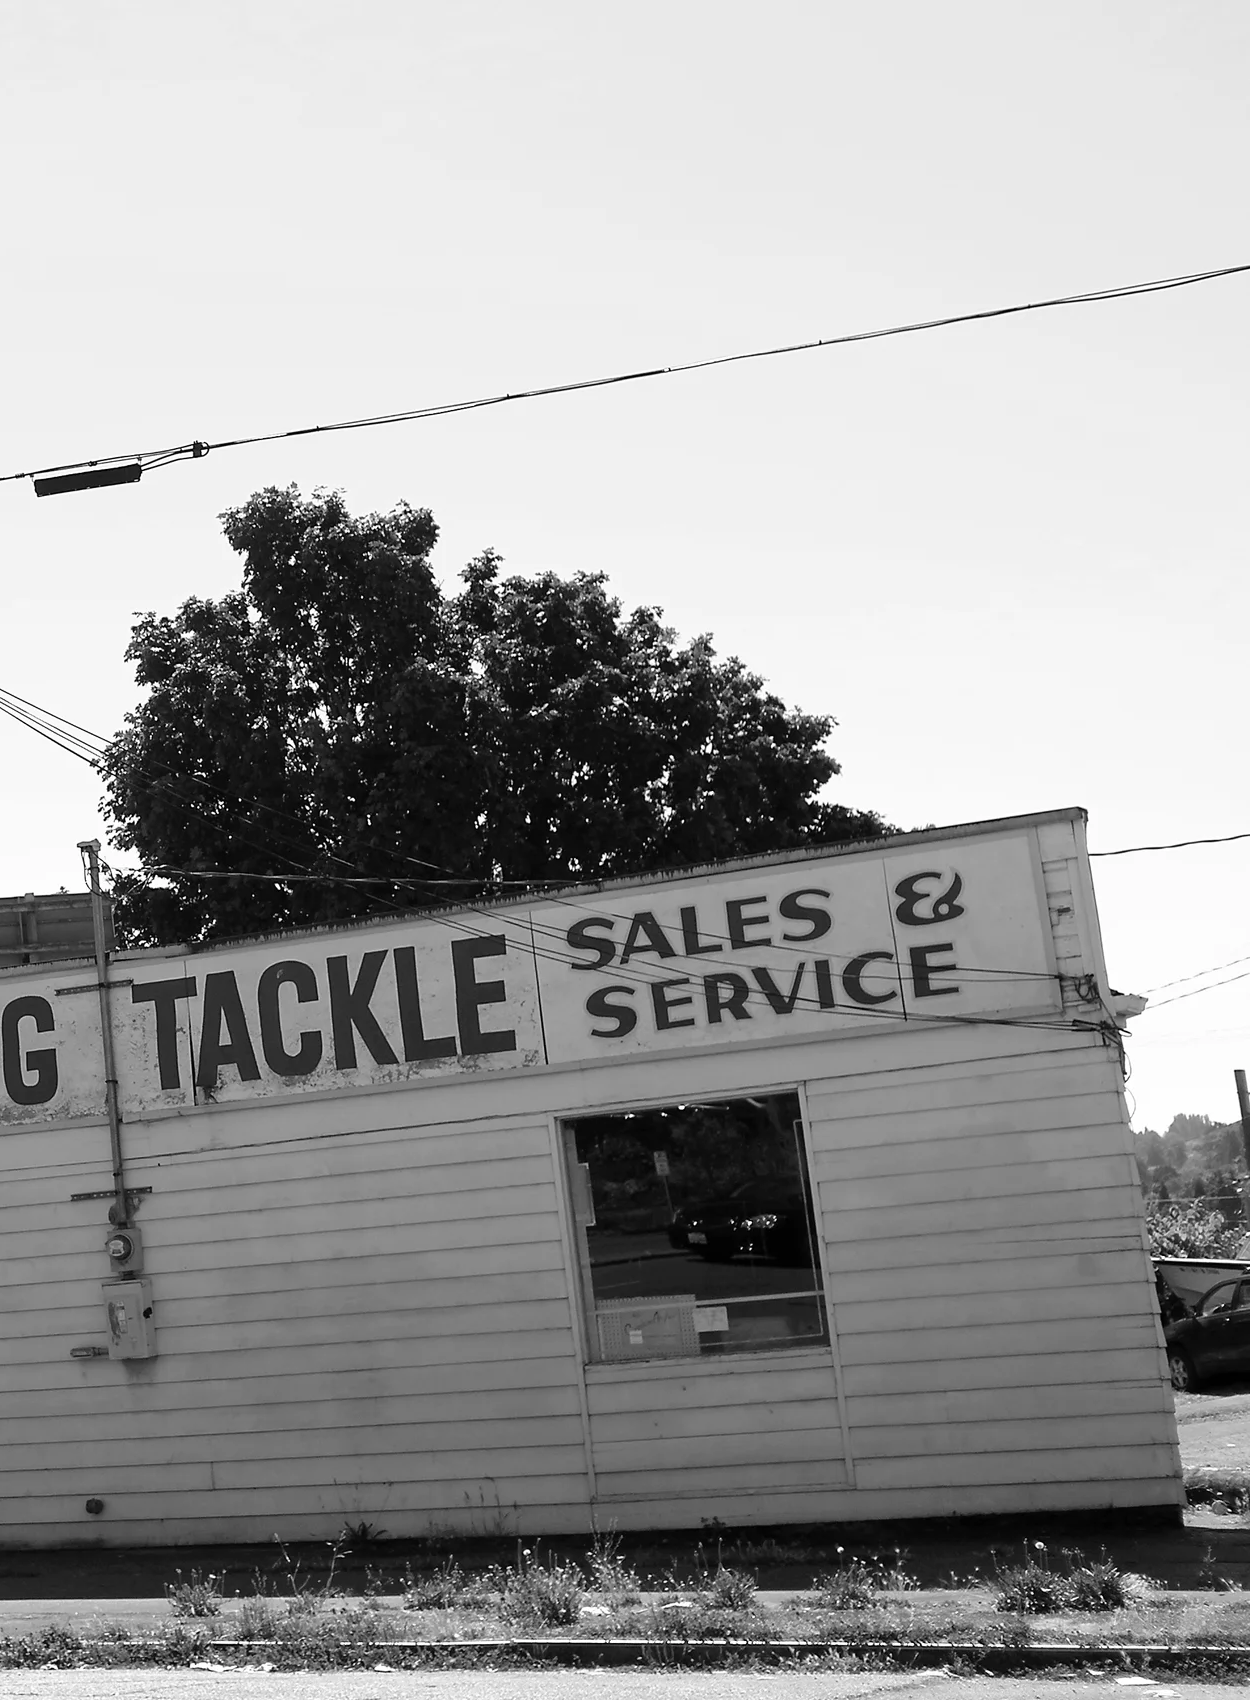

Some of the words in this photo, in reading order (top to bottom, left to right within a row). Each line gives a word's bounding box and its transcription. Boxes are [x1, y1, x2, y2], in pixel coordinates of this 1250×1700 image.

[565, 887, 833, 972] SALES
[894, 871, 965, 927] &
[131, 933, 518, 1091] TACKLE
[584, 942, 961, 1039] SERVICE
